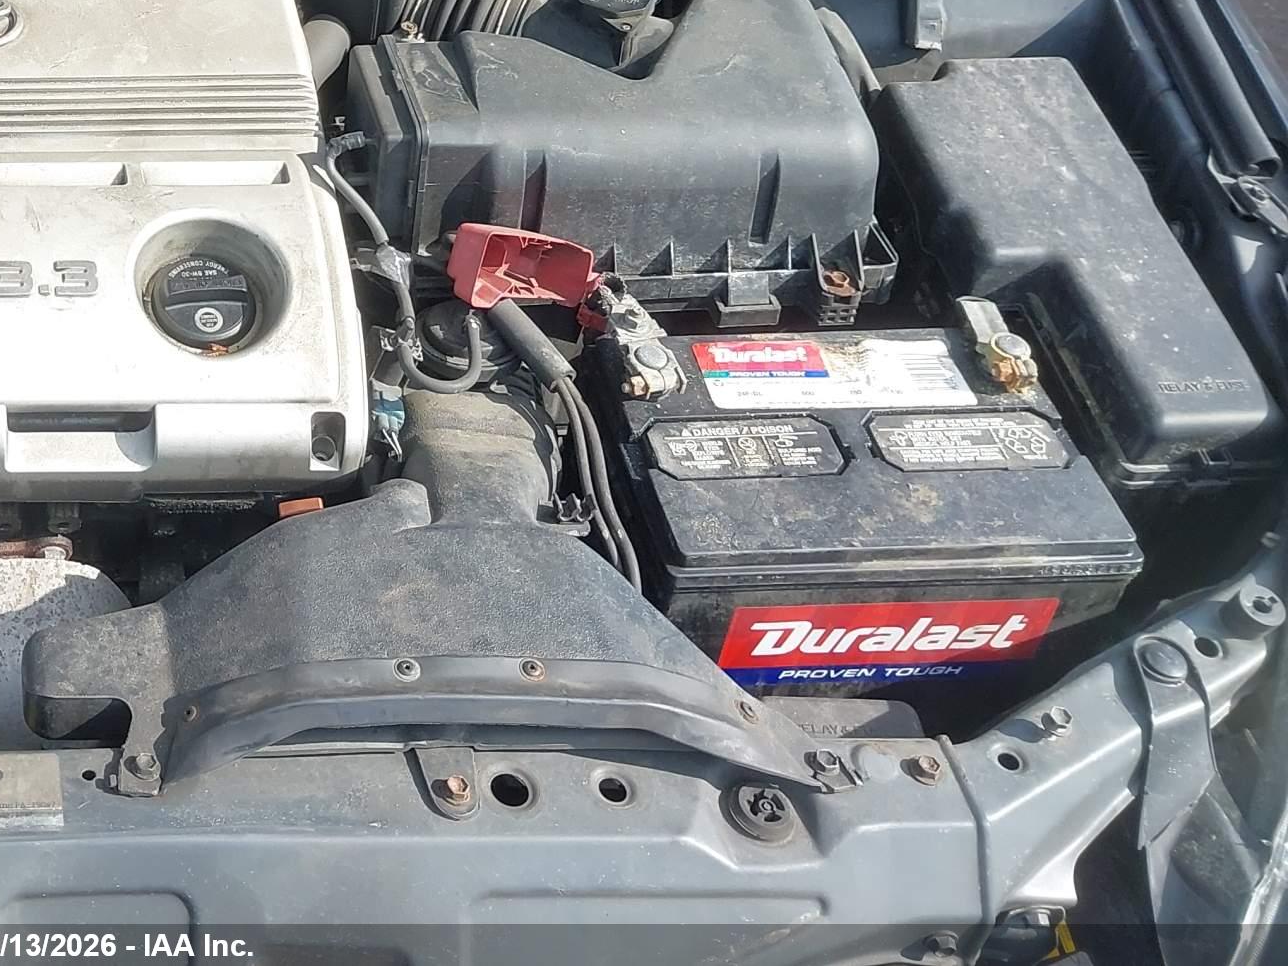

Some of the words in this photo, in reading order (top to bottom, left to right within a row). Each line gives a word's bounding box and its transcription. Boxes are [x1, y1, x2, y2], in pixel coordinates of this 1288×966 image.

[708, 346, 808, 363] Duralast
[772, 370, 806, 378] TOUGH
[1158, 380, 1200, 394] RELAY
[693, 426, 740, 437] DANGER
[751, 423, 794, 435] POISON
[750, 614, 1028, 656] Duralast
[777, 667, 876, 680] PROVEN
[884, 665, 963, 679] TOUGH
